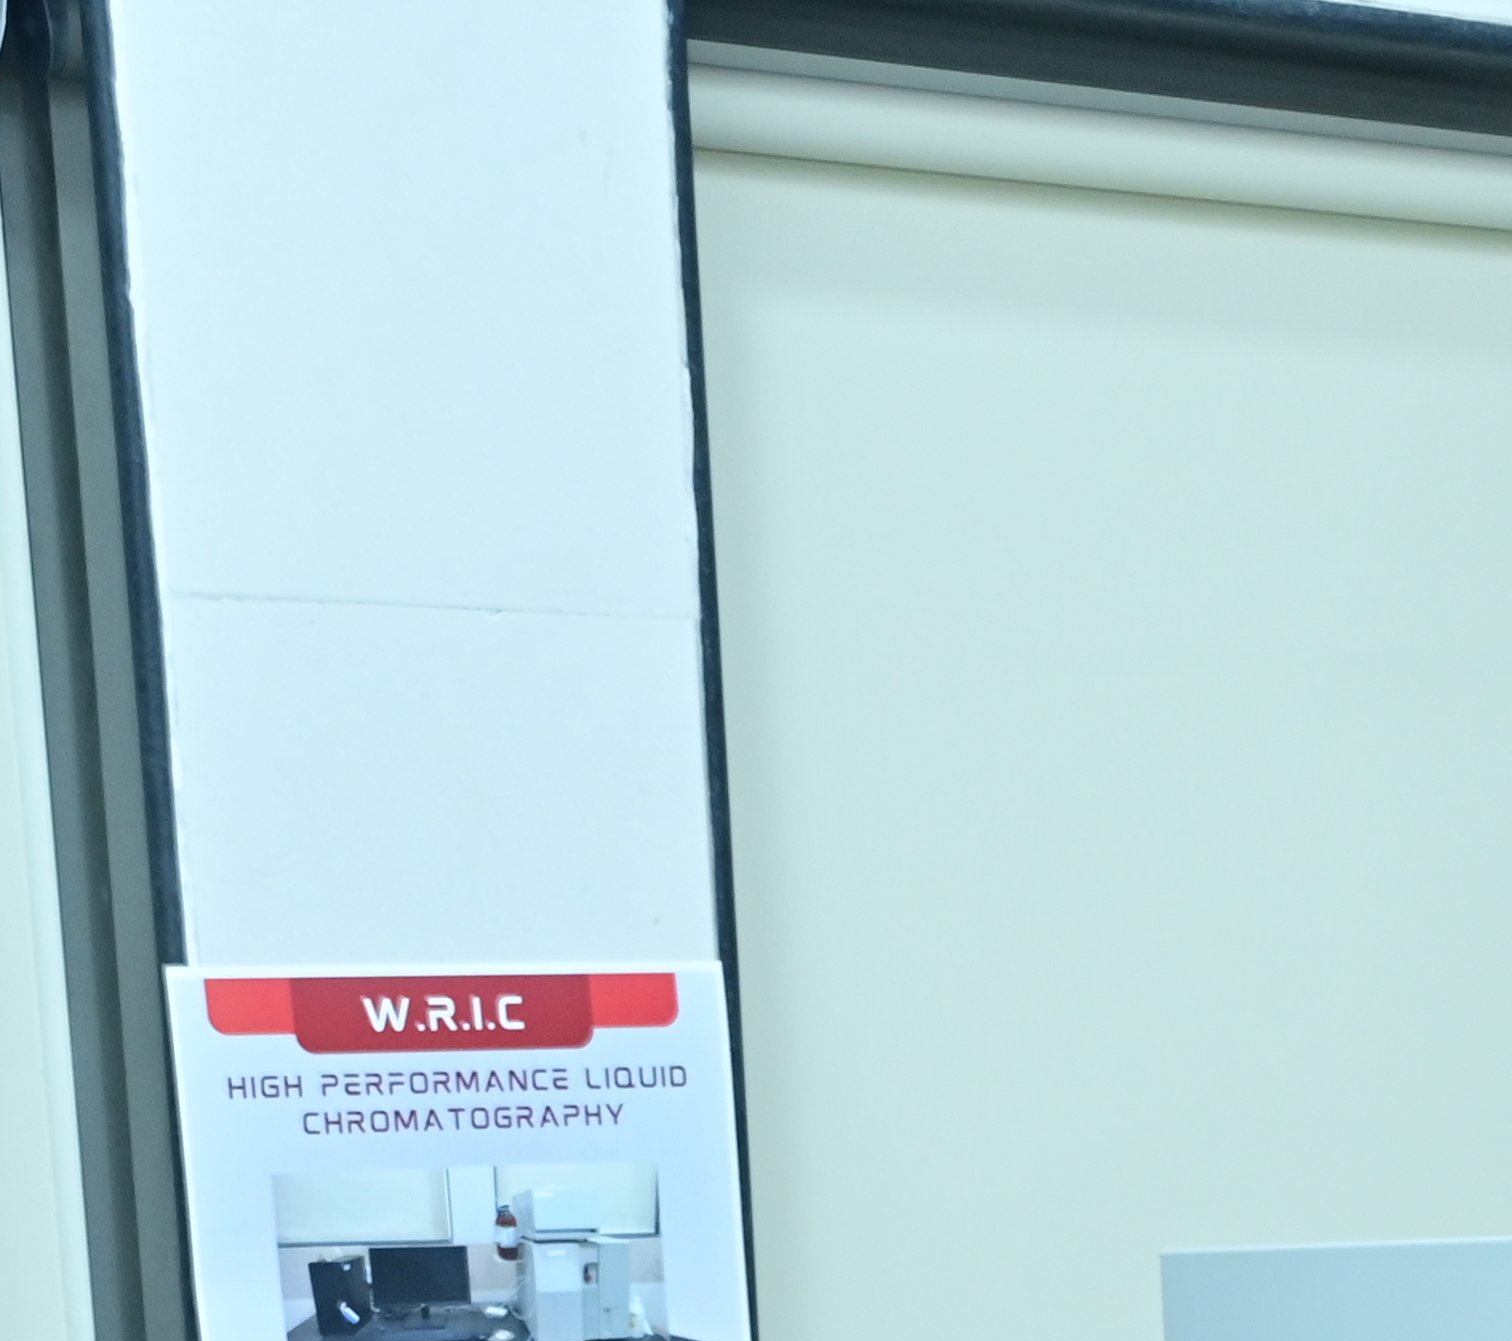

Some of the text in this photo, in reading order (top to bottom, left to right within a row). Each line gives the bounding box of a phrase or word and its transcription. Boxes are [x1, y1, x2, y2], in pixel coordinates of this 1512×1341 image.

[361, 995, 526, 1033] W.R.I.C
[227, 1065, 688, 1099] HIGH PERFORMANCE LIQUID
[303, 1103, 624, 1135] CHROMATOGRAPHY
